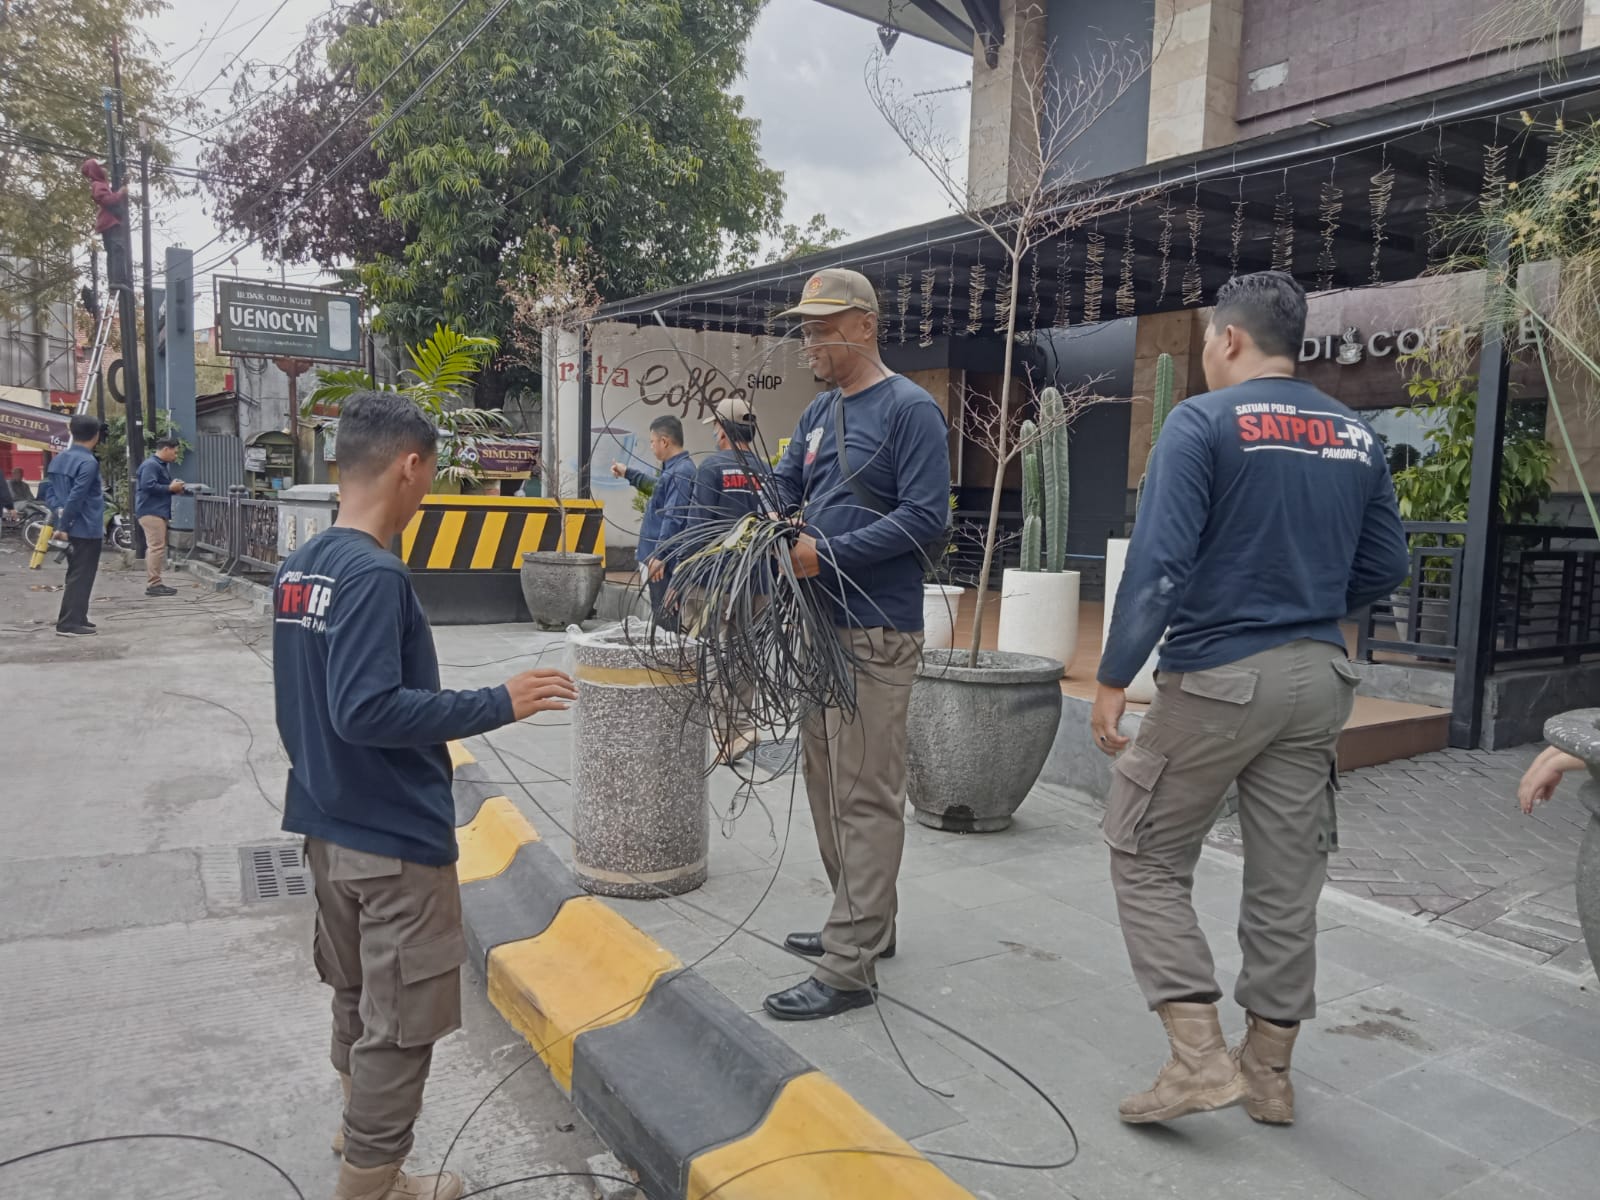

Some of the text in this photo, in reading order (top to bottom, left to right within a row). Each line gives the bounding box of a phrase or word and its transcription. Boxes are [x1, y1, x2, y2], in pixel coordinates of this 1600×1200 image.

[229, 306, 318, 333] VENOCYN
[1368, 316, 1541, 357] COFFE
[747, 374, 782, 390] SHOP
[1235, 402, 1296, 416] SATUAN POLISI
[482, 449, 536, 460] SIMUSTIK
[1321, 447, 1358, 460] PAMONG
